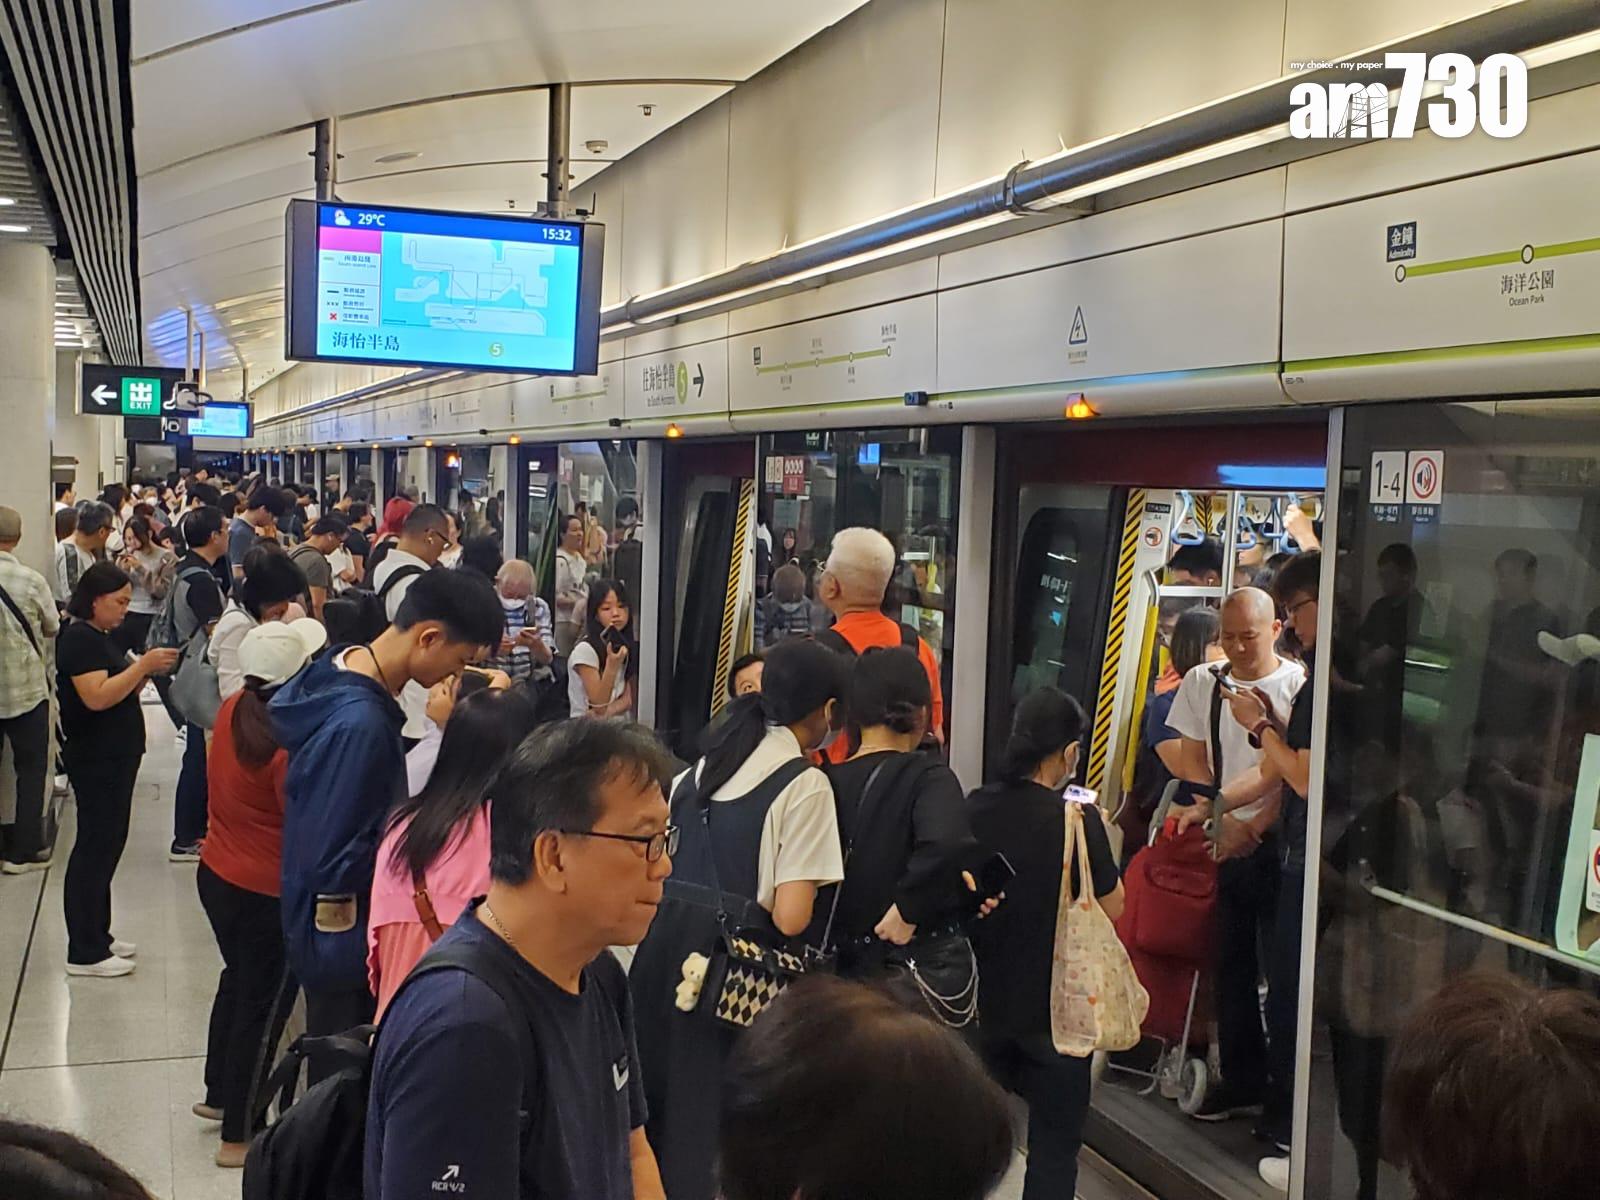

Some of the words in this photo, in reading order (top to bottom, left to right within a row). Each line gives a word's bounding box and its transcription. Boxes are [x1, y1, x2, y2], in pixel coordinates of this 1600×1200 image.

[542, 227, 572, 241] 15:32
[1391, 226, 1414, 247] 金鐘
[1501, 269, 1554, 295] 海洋公園
[1509, 297, 1529, 306] Ocean
[1531, 294, 1545, 304] Park
[332, 331, 400, 352] 海怡半島
[492, 343, 501, 356] 5
[130, 382, 152, 402] 出
[1375, 459, 1401, 498] 1-4
